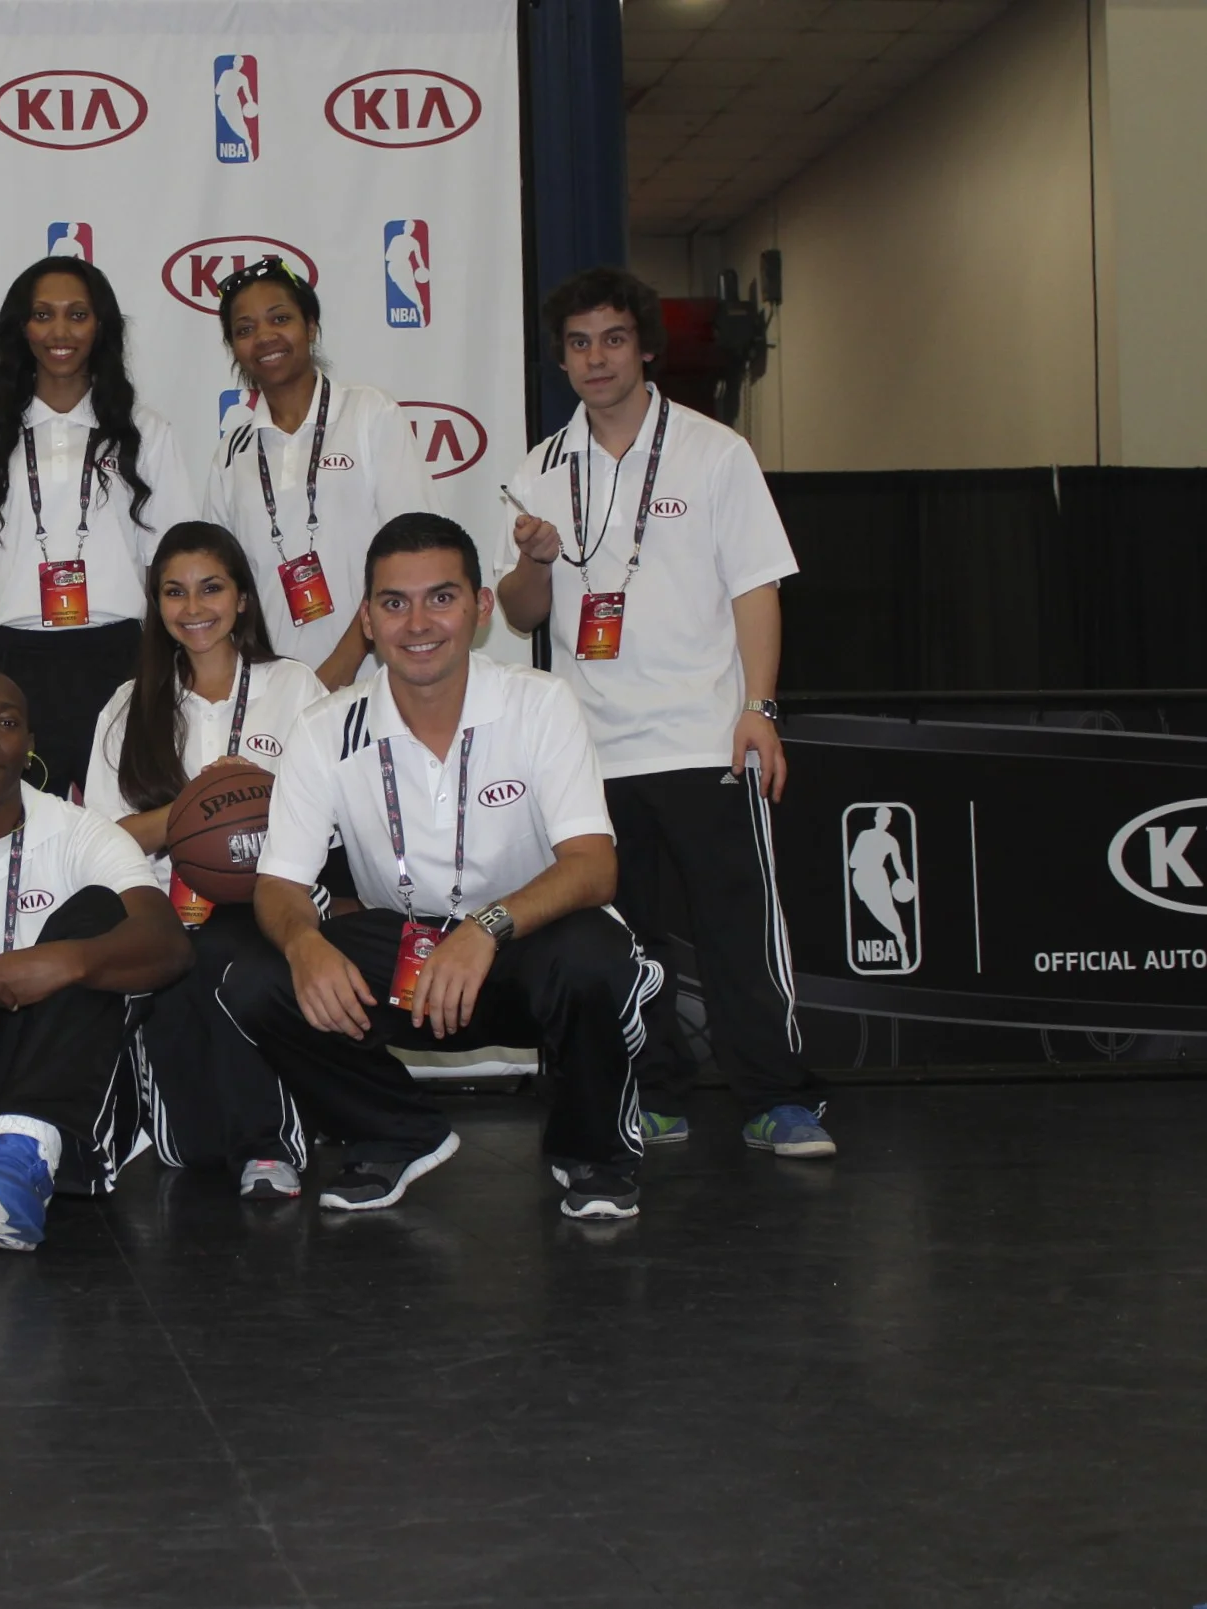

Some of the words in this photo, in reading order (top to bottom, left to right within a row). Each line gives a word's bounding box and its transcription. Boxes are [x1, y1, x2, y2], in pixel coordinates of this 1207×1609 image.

[15, 89, 121, 131] KIA
[351, 88, 456, 130] KIA
[219, 142, 246, 158] NBA
[390, 308, 418, 323] NBA
[323, 456, 348, 468] KIA
[655, 502, 681, 514] KIA
[60, 595, 68, 608] 1
[304, 590, 313, 603] 1
[597, 628, 604, 642] 1
[254, 738, 277, 754] KIA
[484, 784, 520, 804] KIA
[20, 894, 47, 910] KIA
[857, 940, 899, 963] NBA
[1034, 951, 1137, 973] OFFICIAL
[1144, 949, 1207, 970] AUTO
